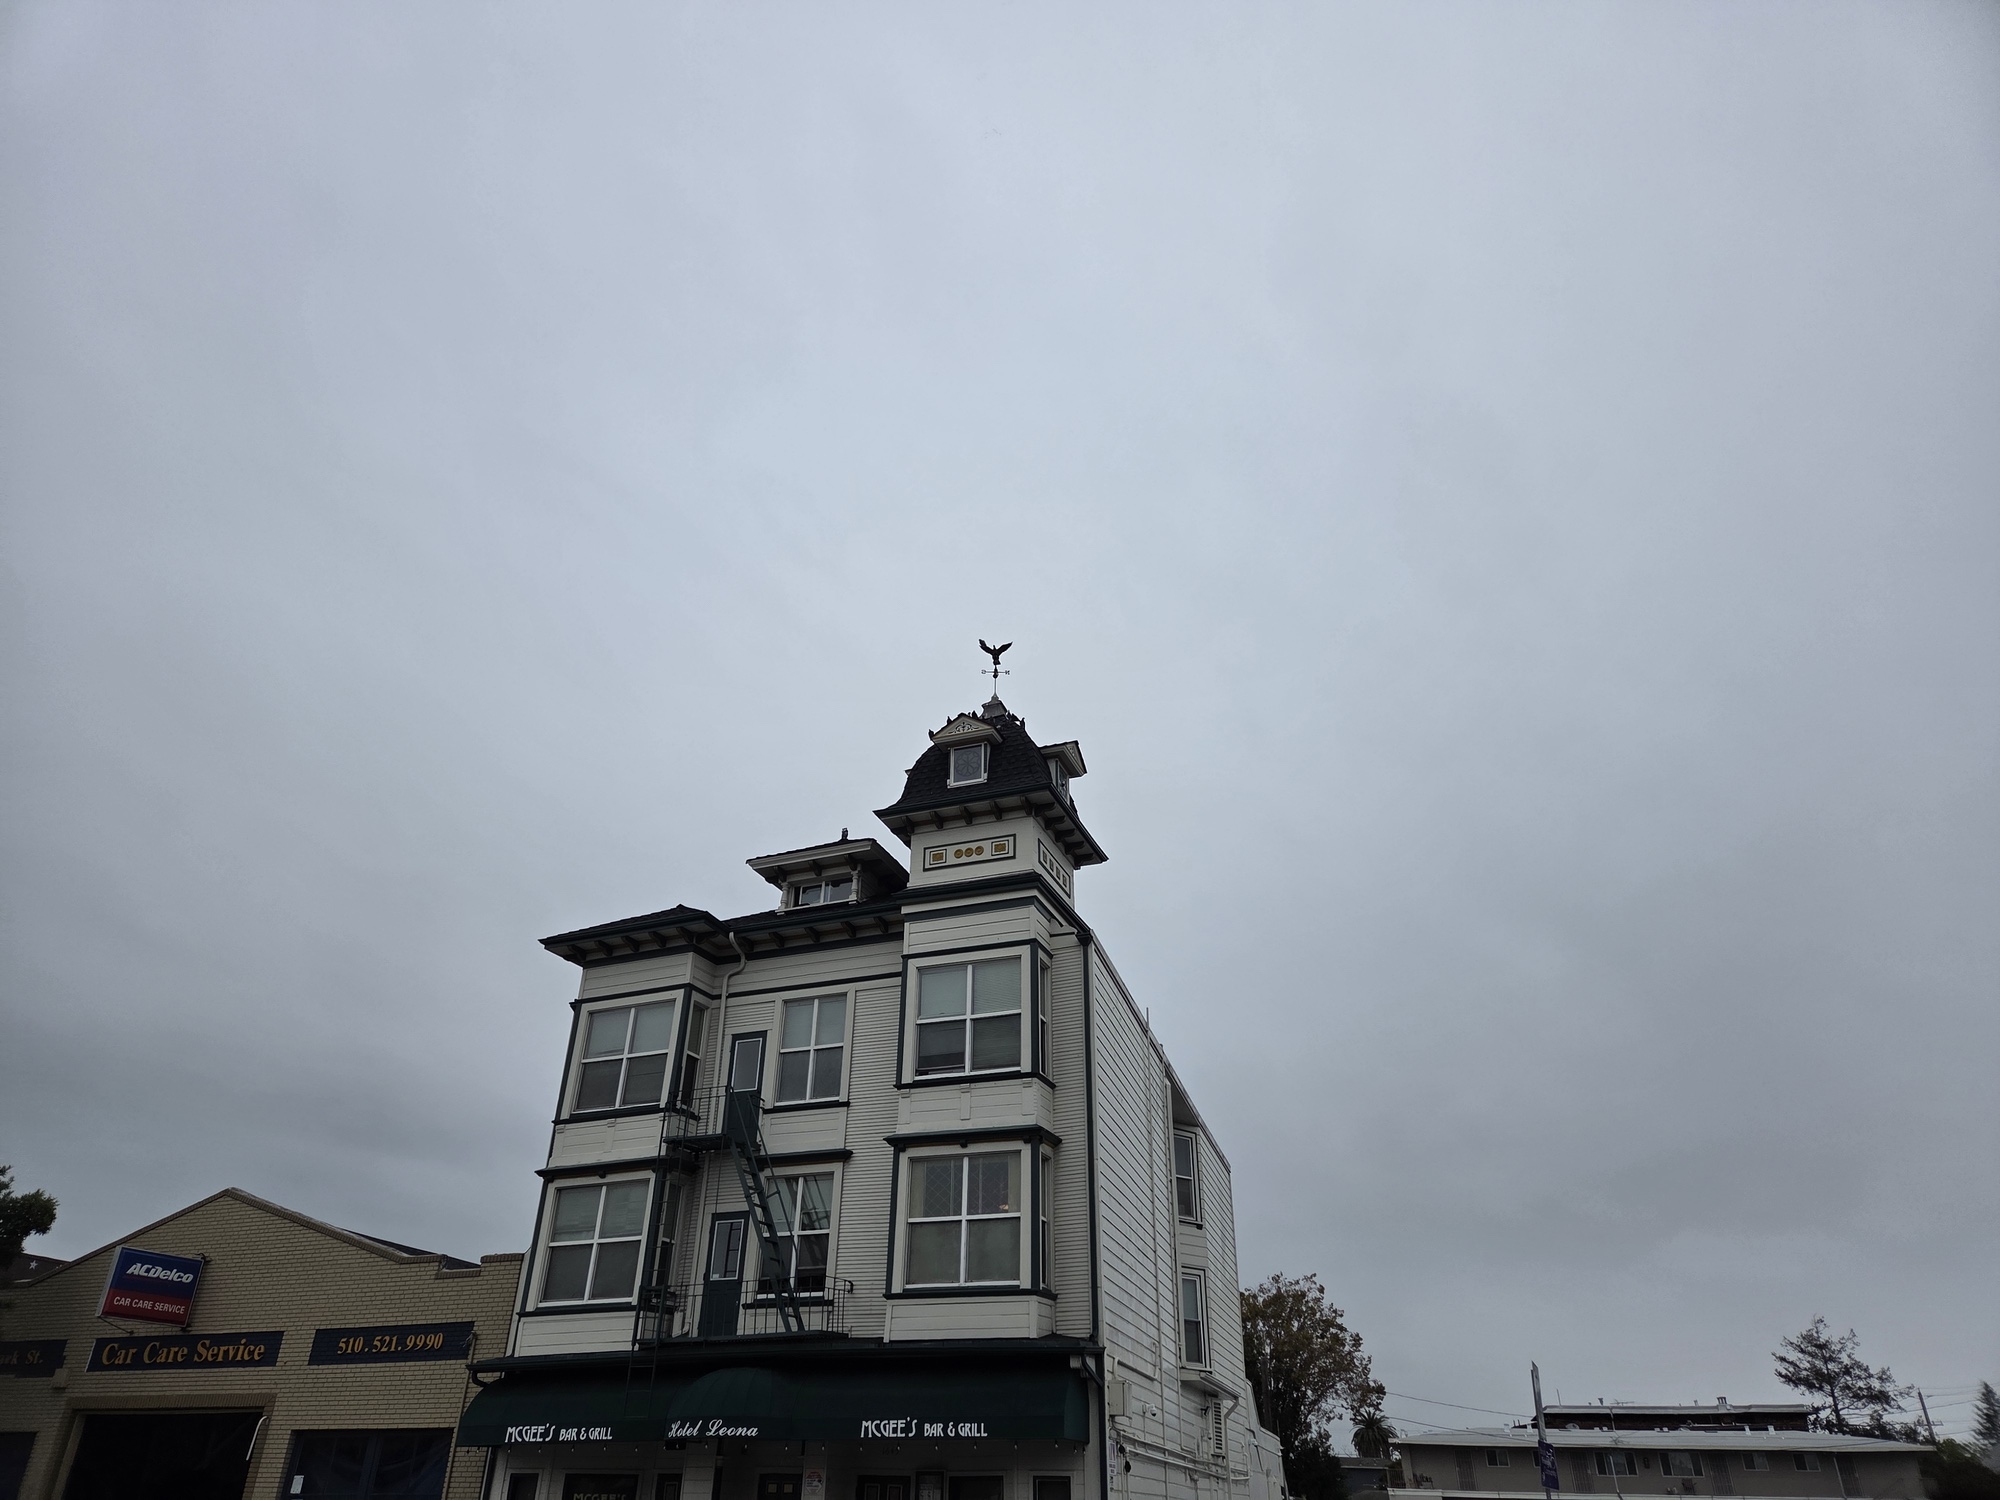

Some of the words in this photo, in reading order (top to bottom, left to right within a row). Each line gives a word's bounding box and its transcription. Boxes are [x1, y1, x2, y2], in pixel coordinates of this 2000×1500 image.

[126, 1262, 194, 1283] ACDelco
[113, 1296, 132, 1307] CAR
[132, 1299, 153, 1310] CARE
[154, 1302, 185, 1314] SERVICE
[102, 1343, 137, 1365] Car
[143, 1341, 188, 1364] Care
[194, 1338, 265, 1363] Service
[504, 1422, 556, 1443] MCGEE'S
[559, 1428, 578, 1441] BAR
[580, 1427, 587, 1440] &
[588, 1427, 613, 1440] GRILL
[668, 1420, 702, 1438] Hotel
[705, 1418, 759, 1437] Leona
[860, 1416, 918, 1438] MCGEE'S
[923, 1423, 944, 1437] BAR
[947, 1421, 955, 1437] &
[957, 1422, 988, 1437] GRILL
